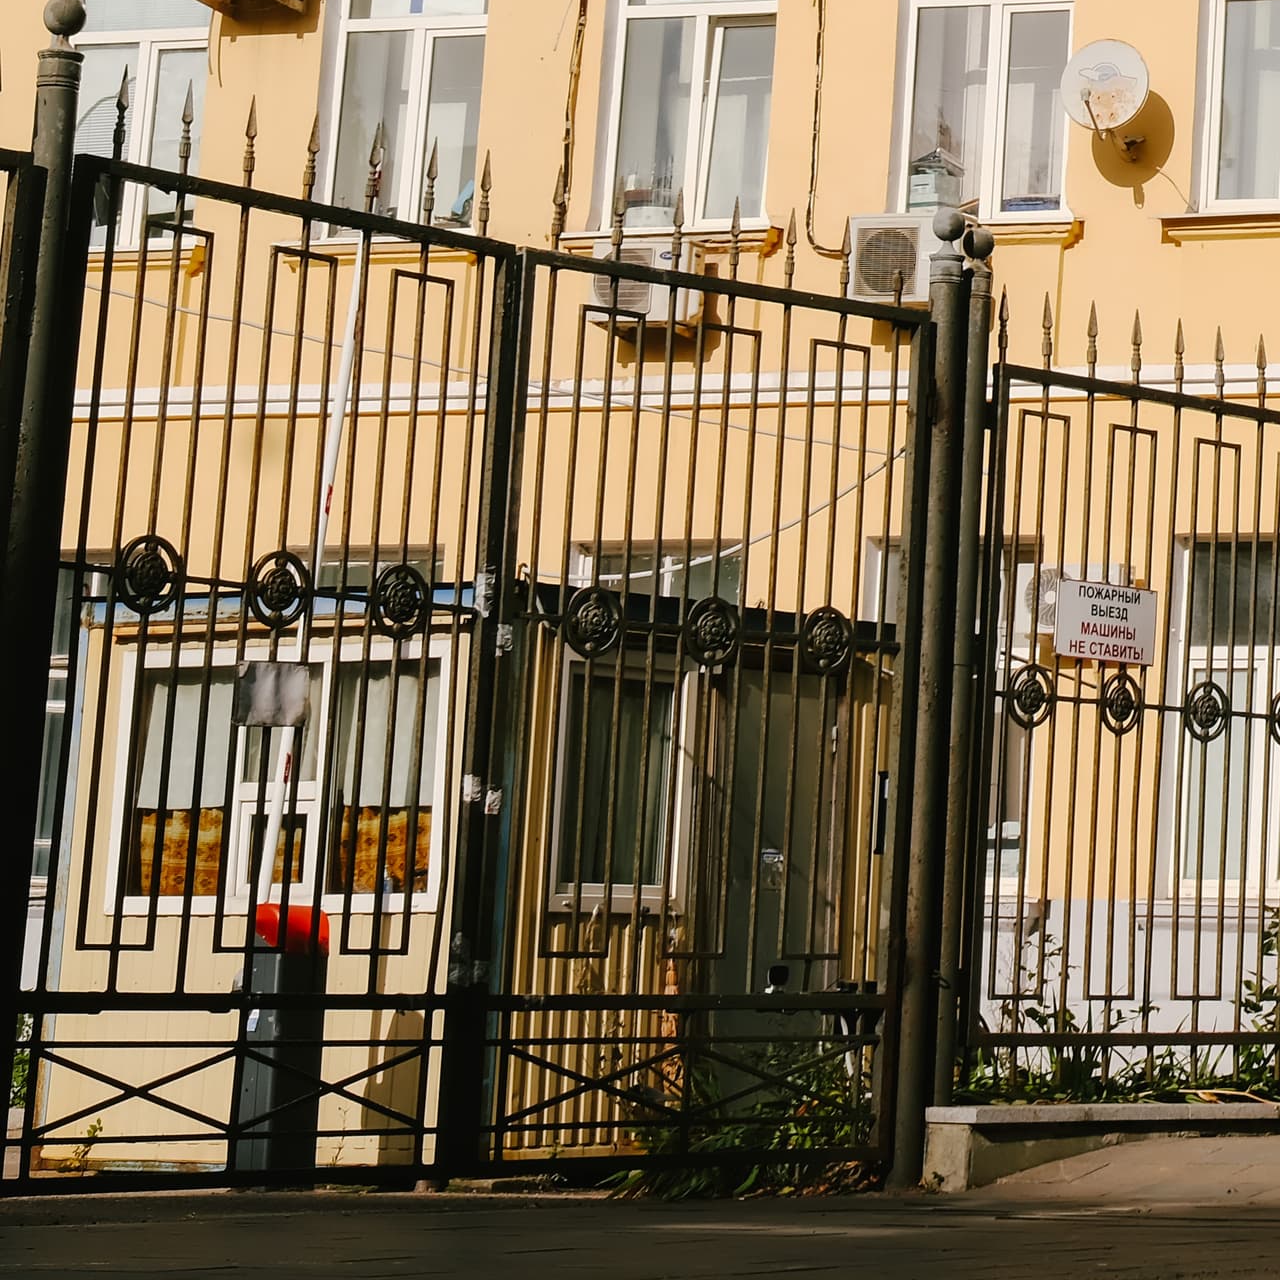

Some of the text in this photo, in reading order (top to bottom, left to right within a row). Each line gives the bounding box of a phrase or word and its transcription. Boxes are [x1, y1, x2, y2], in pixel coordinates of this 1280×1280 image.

[1078, 585, 1141, 605] ПОЖАРНЫЙ
[1091, 604, 1128, 622] ВЫЕЗД
[1081, 622, 1136, 641] МАШИНЫ
[1069, 640, 1144, 660] НЕ СТАВИТЬ!
